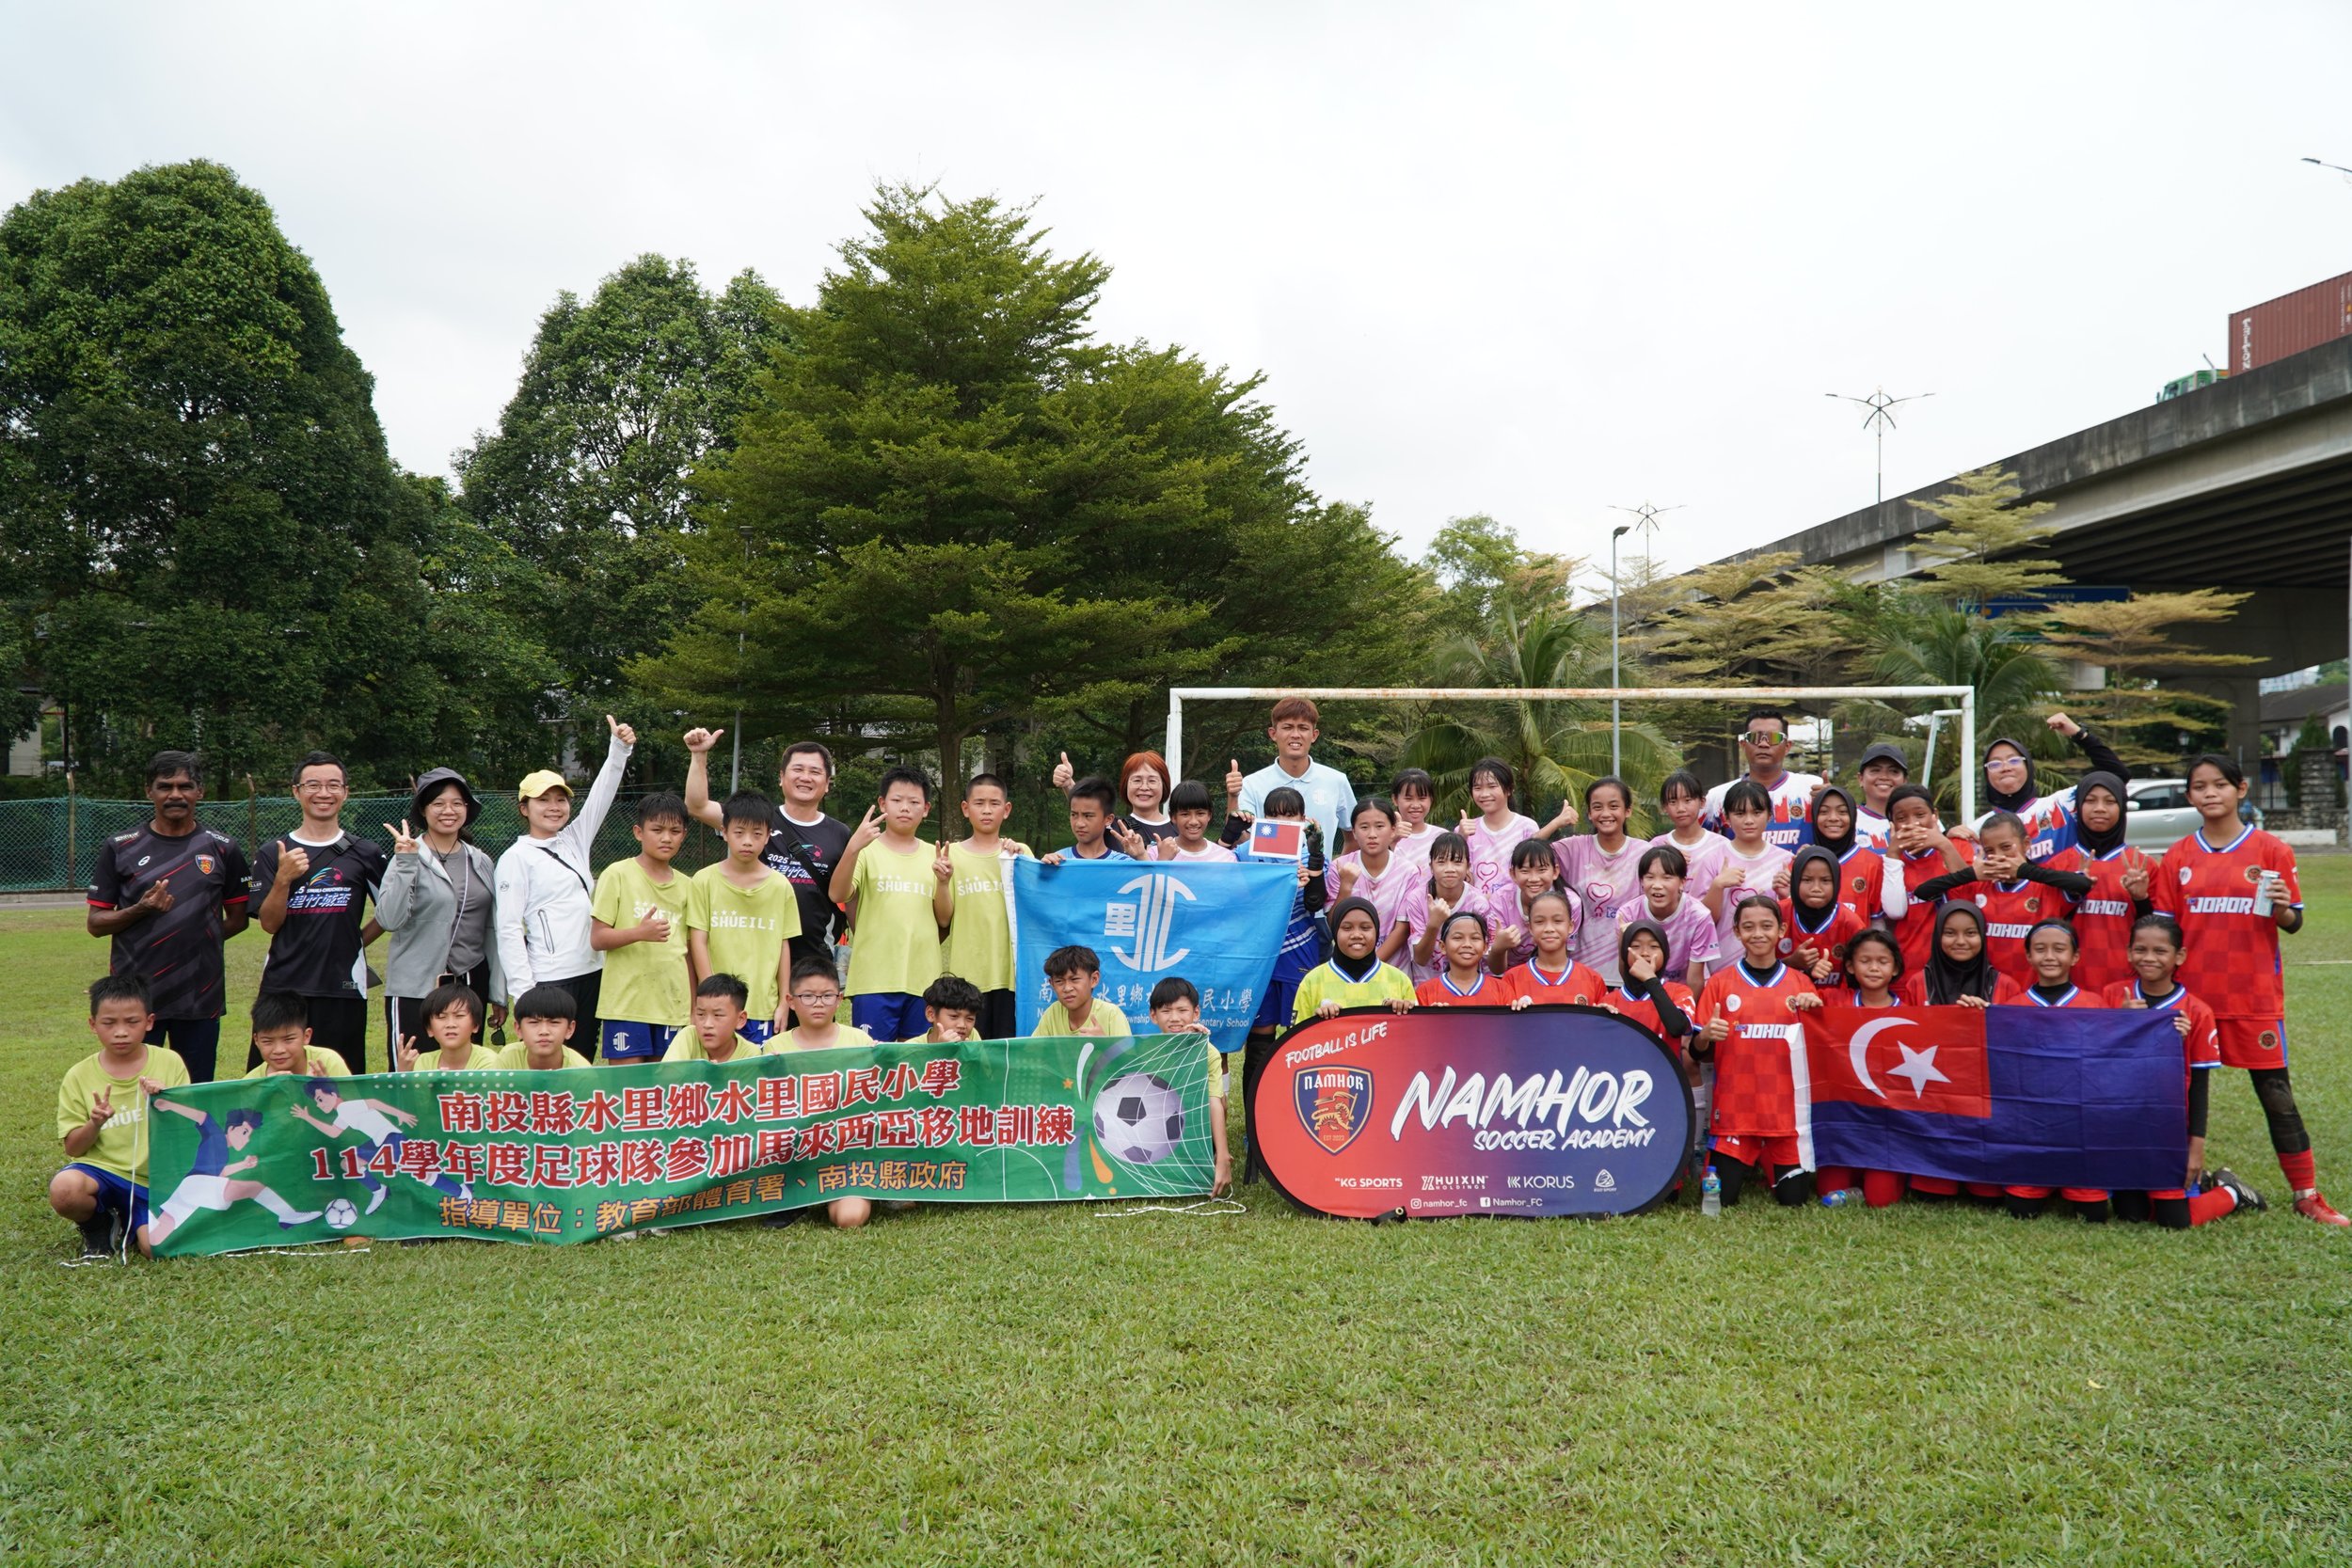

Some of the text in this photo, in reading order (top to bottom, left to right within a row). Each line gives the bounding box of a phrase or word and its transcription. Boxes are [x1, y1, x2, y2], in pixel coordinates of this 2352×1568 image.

[767, 853, 789, 863] 2025
[2190, 896, 2255, 915] JOHOR
[711, 915, 775, 931] SHUEILI
[1227, 1017, 1249, 1028] School
[1740, 1024, 1788, 1039] JOHO
[1285, 1022, 1388, 1069] FOOTBALL IS LIFE
[1304, 1073, 1364, 1091] NAMHOR
[437, 1058, 961, 1135] 南投縣水里鄉水里國民小學
[1391, 1066, 1654, 1142] NAMHOR
[310, 1103, 1076, 1189] 114學年度足球隊參加馬來西亞移地訓練
[1473, 1128, 1657, 1151] SOCCER ACADEMY
[1359, 1177, 1404, 1188] SPORTS
[1435, 1176, 1486, 1185] HUIXIN
[1523, 1176, 1575, 1189] KORUS
[438, 1159, 968, 1235] 指導單位：教育部體育署、南投縣政府
[1422, 1196, 1543, 1209] namhor_fc Namhor_FC
